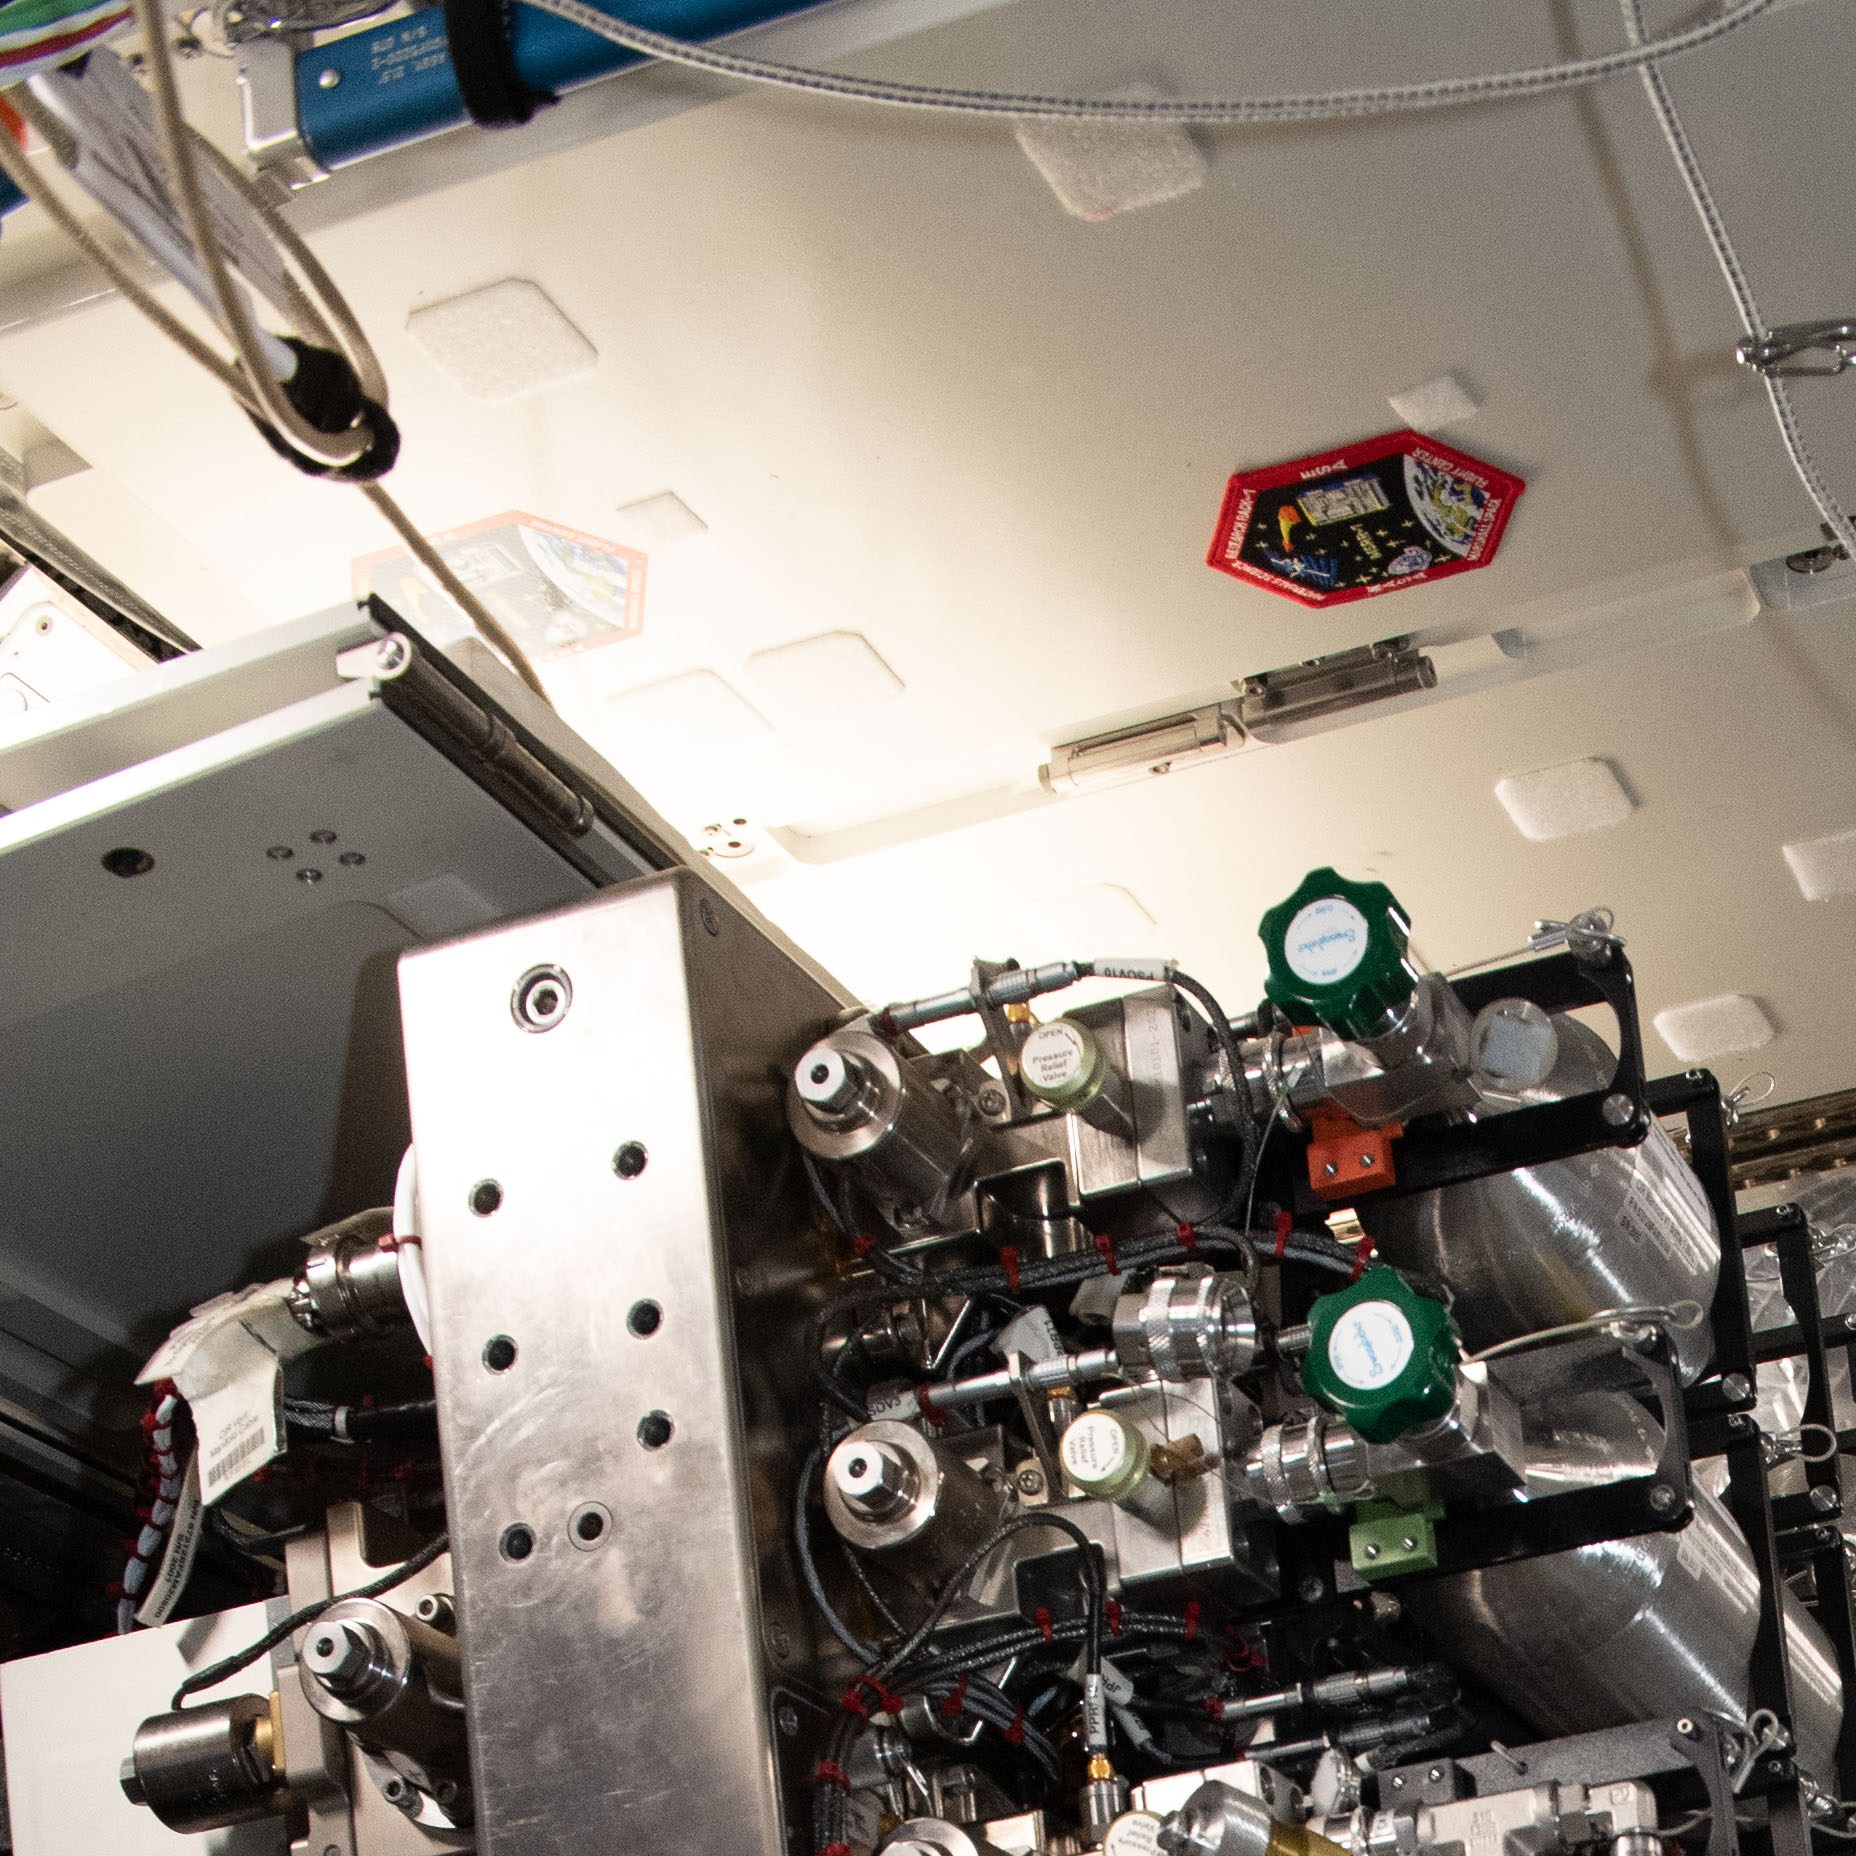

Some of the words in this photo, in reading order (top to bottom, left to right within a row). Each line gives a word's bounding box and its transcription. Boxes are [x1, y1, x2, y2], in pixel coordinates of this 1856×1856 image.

[1300, 460, 1350, 481] ESA
[1038, 1027, 1065, 1041] OPEN
[1031, 1048, 1075, 1066] Pressure
[1042, 1060, 1069, 1074] Relief
